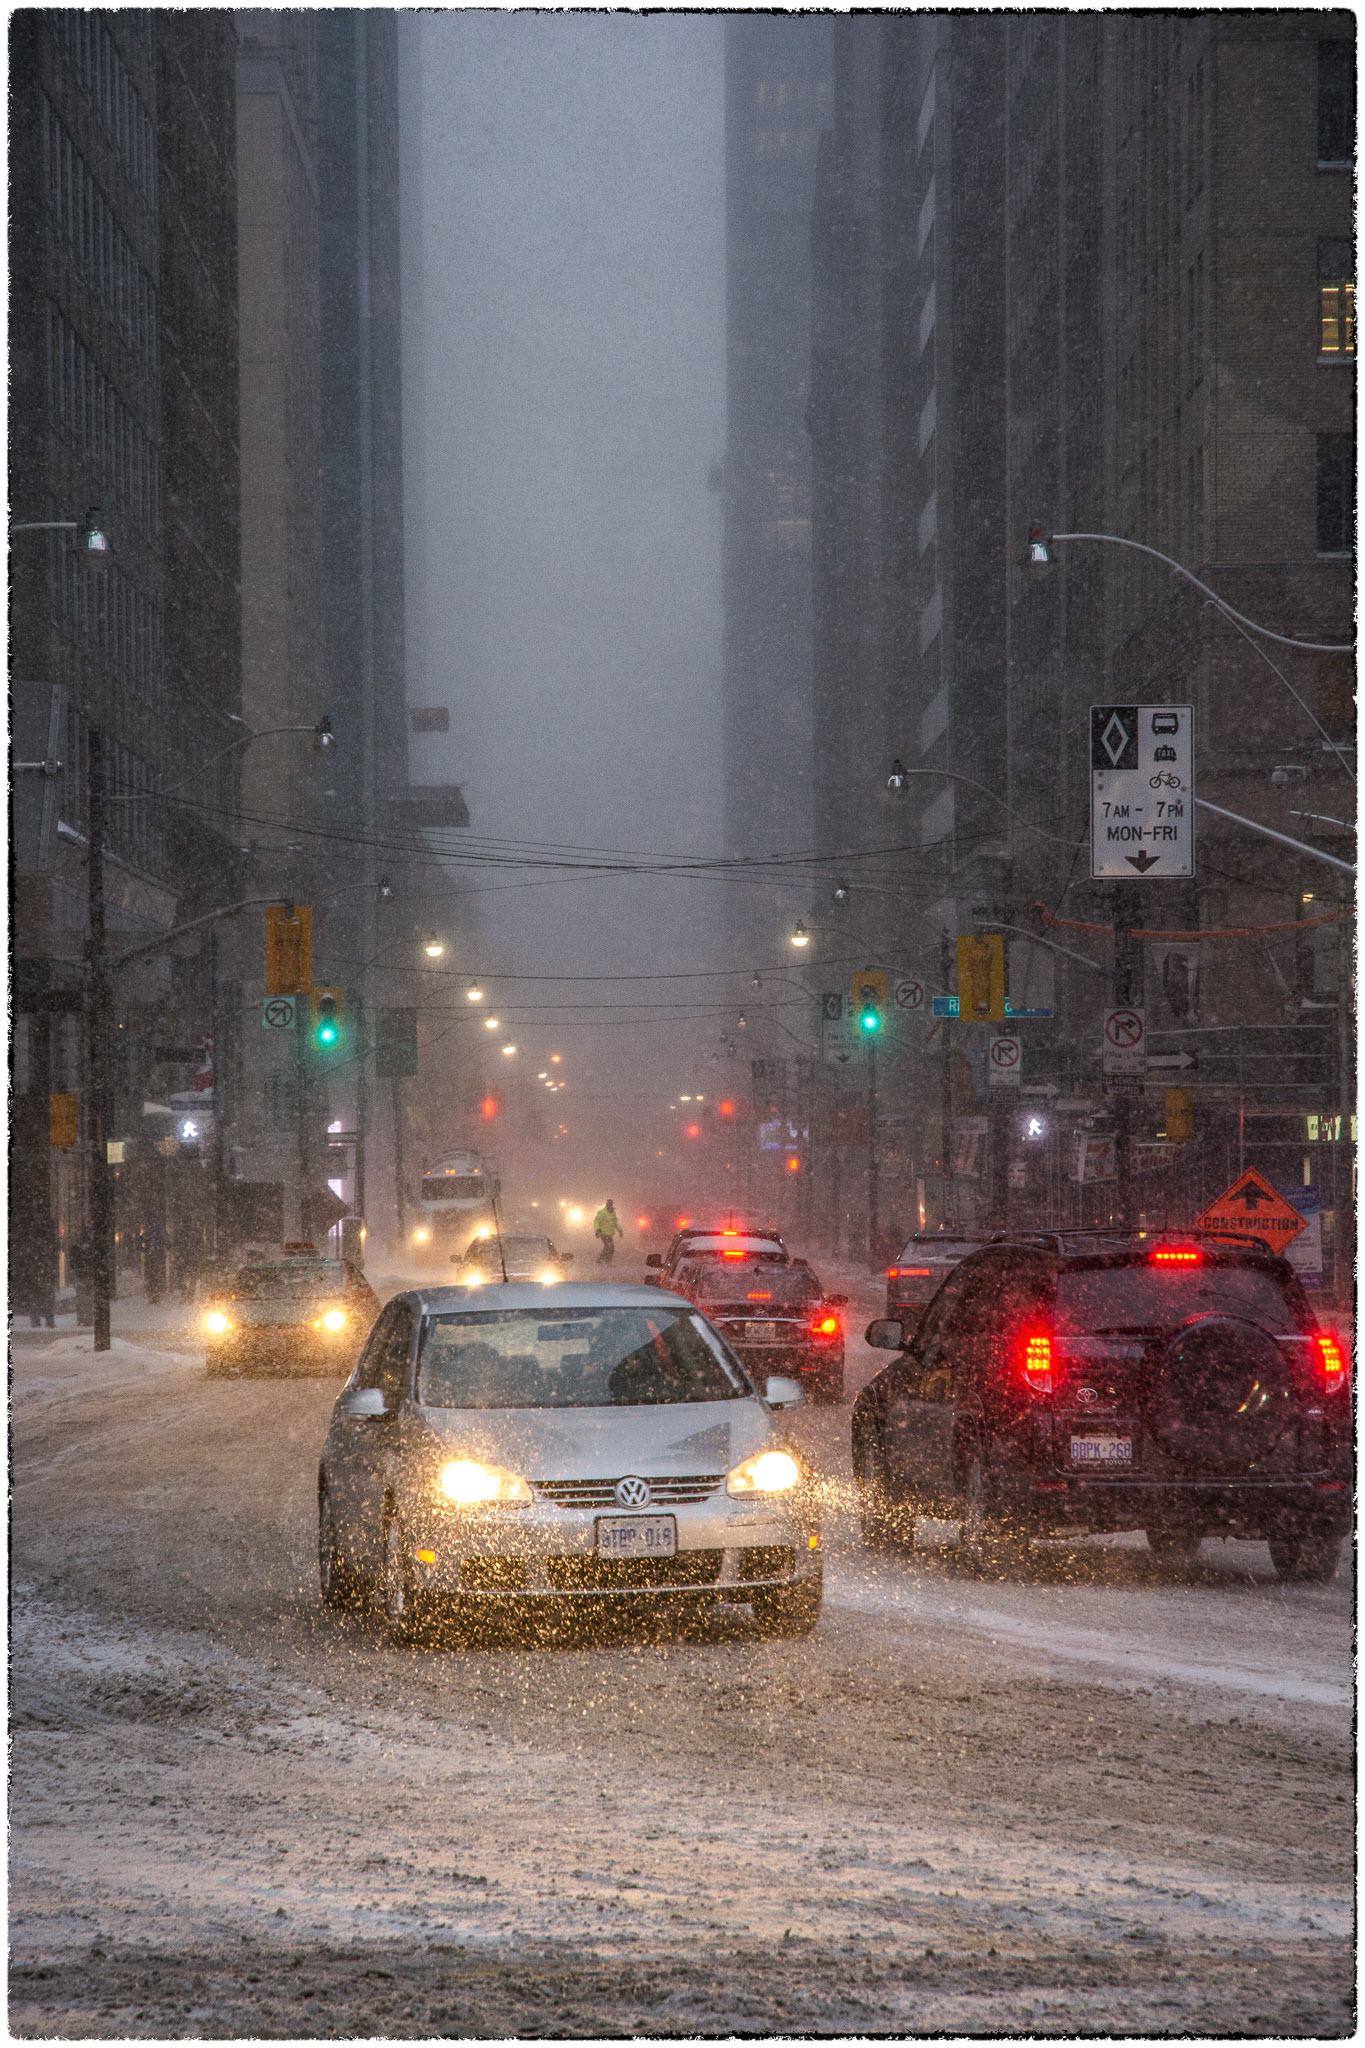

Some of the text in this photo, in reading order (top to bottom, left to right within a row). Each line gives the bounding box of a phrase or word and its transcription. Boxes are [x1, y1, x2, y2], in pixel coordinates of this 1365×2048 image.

[1157, 749, 1174, 758] TAXI
[1107, 825, 1177, 841] MON-FRI
[1203, 1216, 1298, 1231] CONSTRUCTION
